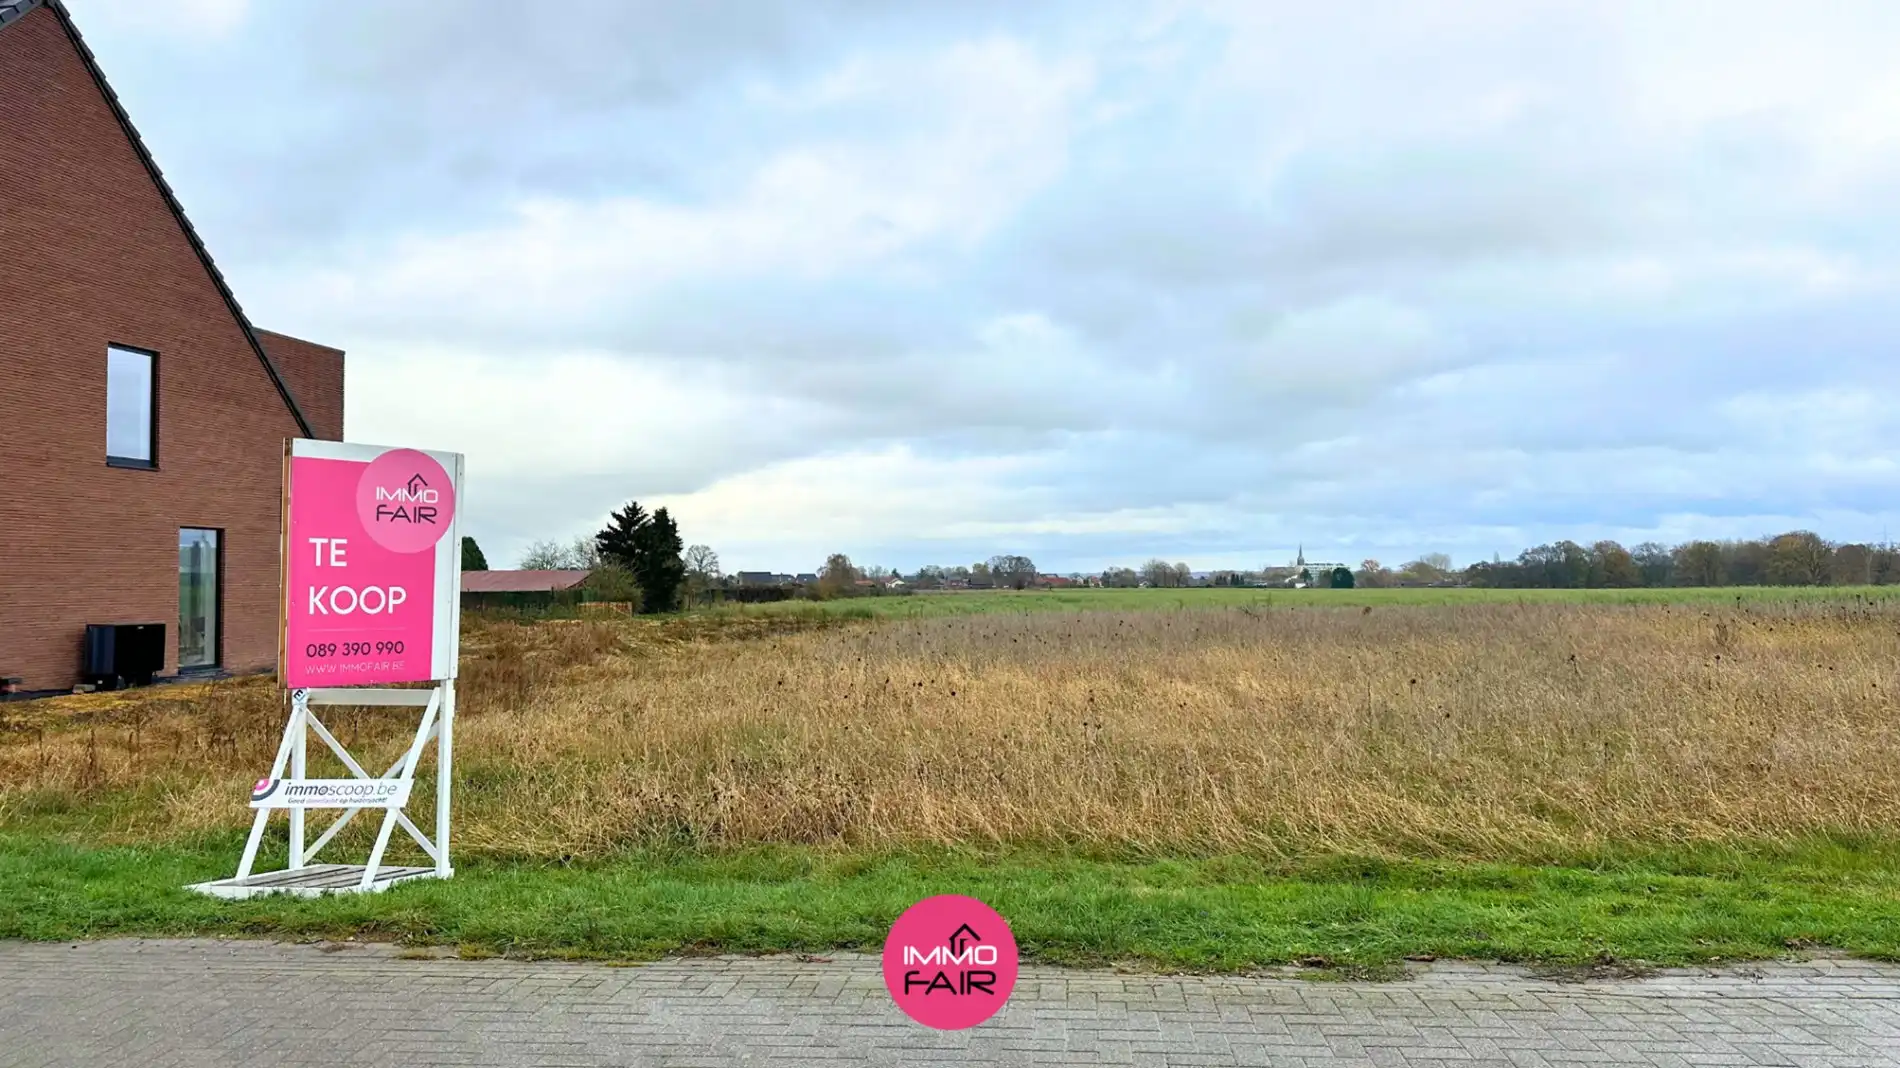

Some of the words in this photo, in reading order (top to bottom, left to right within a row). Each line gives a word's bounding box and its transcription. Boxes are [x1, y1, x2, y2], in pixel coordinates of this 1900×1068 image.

[376, 486, 439, 503] IMMO
[376, 504, 438, 525] FAIR
[308, 537, 348, 567] TE
[308, 586, 407, 615] KOOP
[306, 643, 337, 658] 089
[342, 642, 371, 656] 390
[376, 640, 405, 655] 990
[305, 660, 406, 675] WWWIMMOFAIRBE
[284, 781, 399, 798] immoscoop.be
